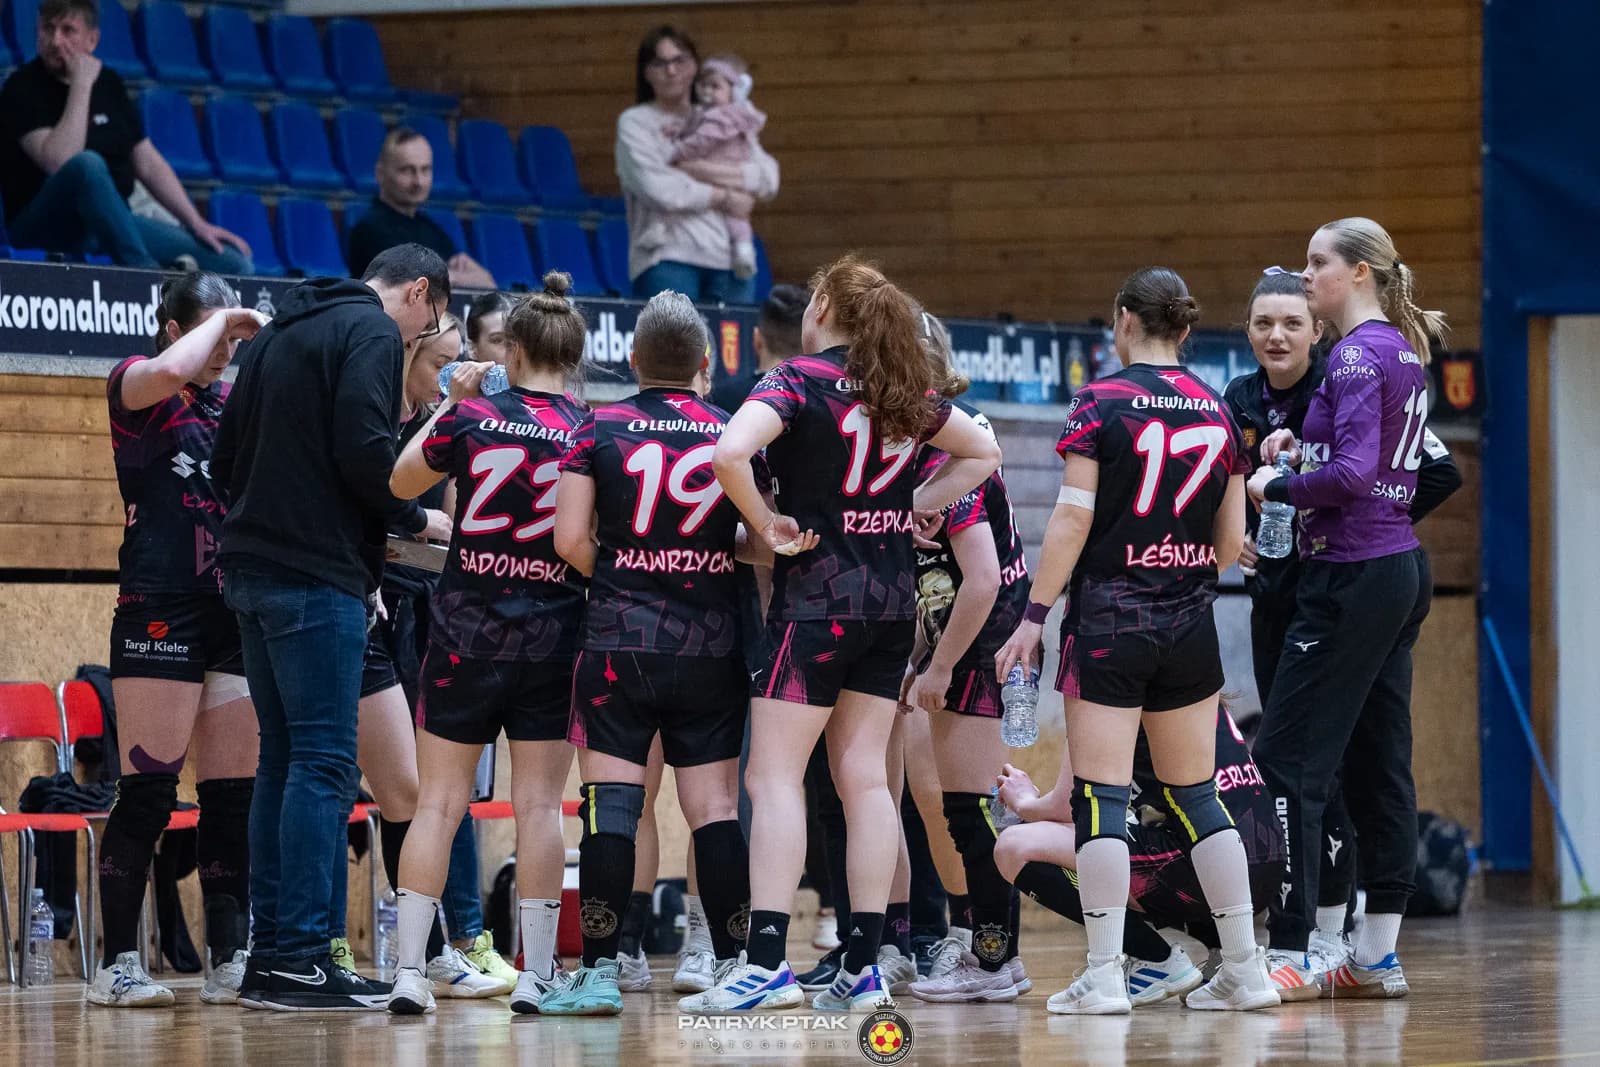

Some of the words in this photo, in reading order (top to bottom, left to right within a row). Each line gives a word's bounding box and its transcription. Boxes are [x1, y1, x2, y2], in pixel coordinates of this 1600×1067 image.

[0, 280, 163, 336] koronahand
[1151, 395, 1219, 412] LEWIATAN
[1391, 385, 1428, 471] 12
[460, 444, 561, 543] 23
[622, 439, 727, 537] 19
[1133, 418, 1228, 517] 17
[843, 509, 914, 534] RZEPKA
[124, 639, 151, 653] Targi
[154, 641, 189, 653] Kielce
